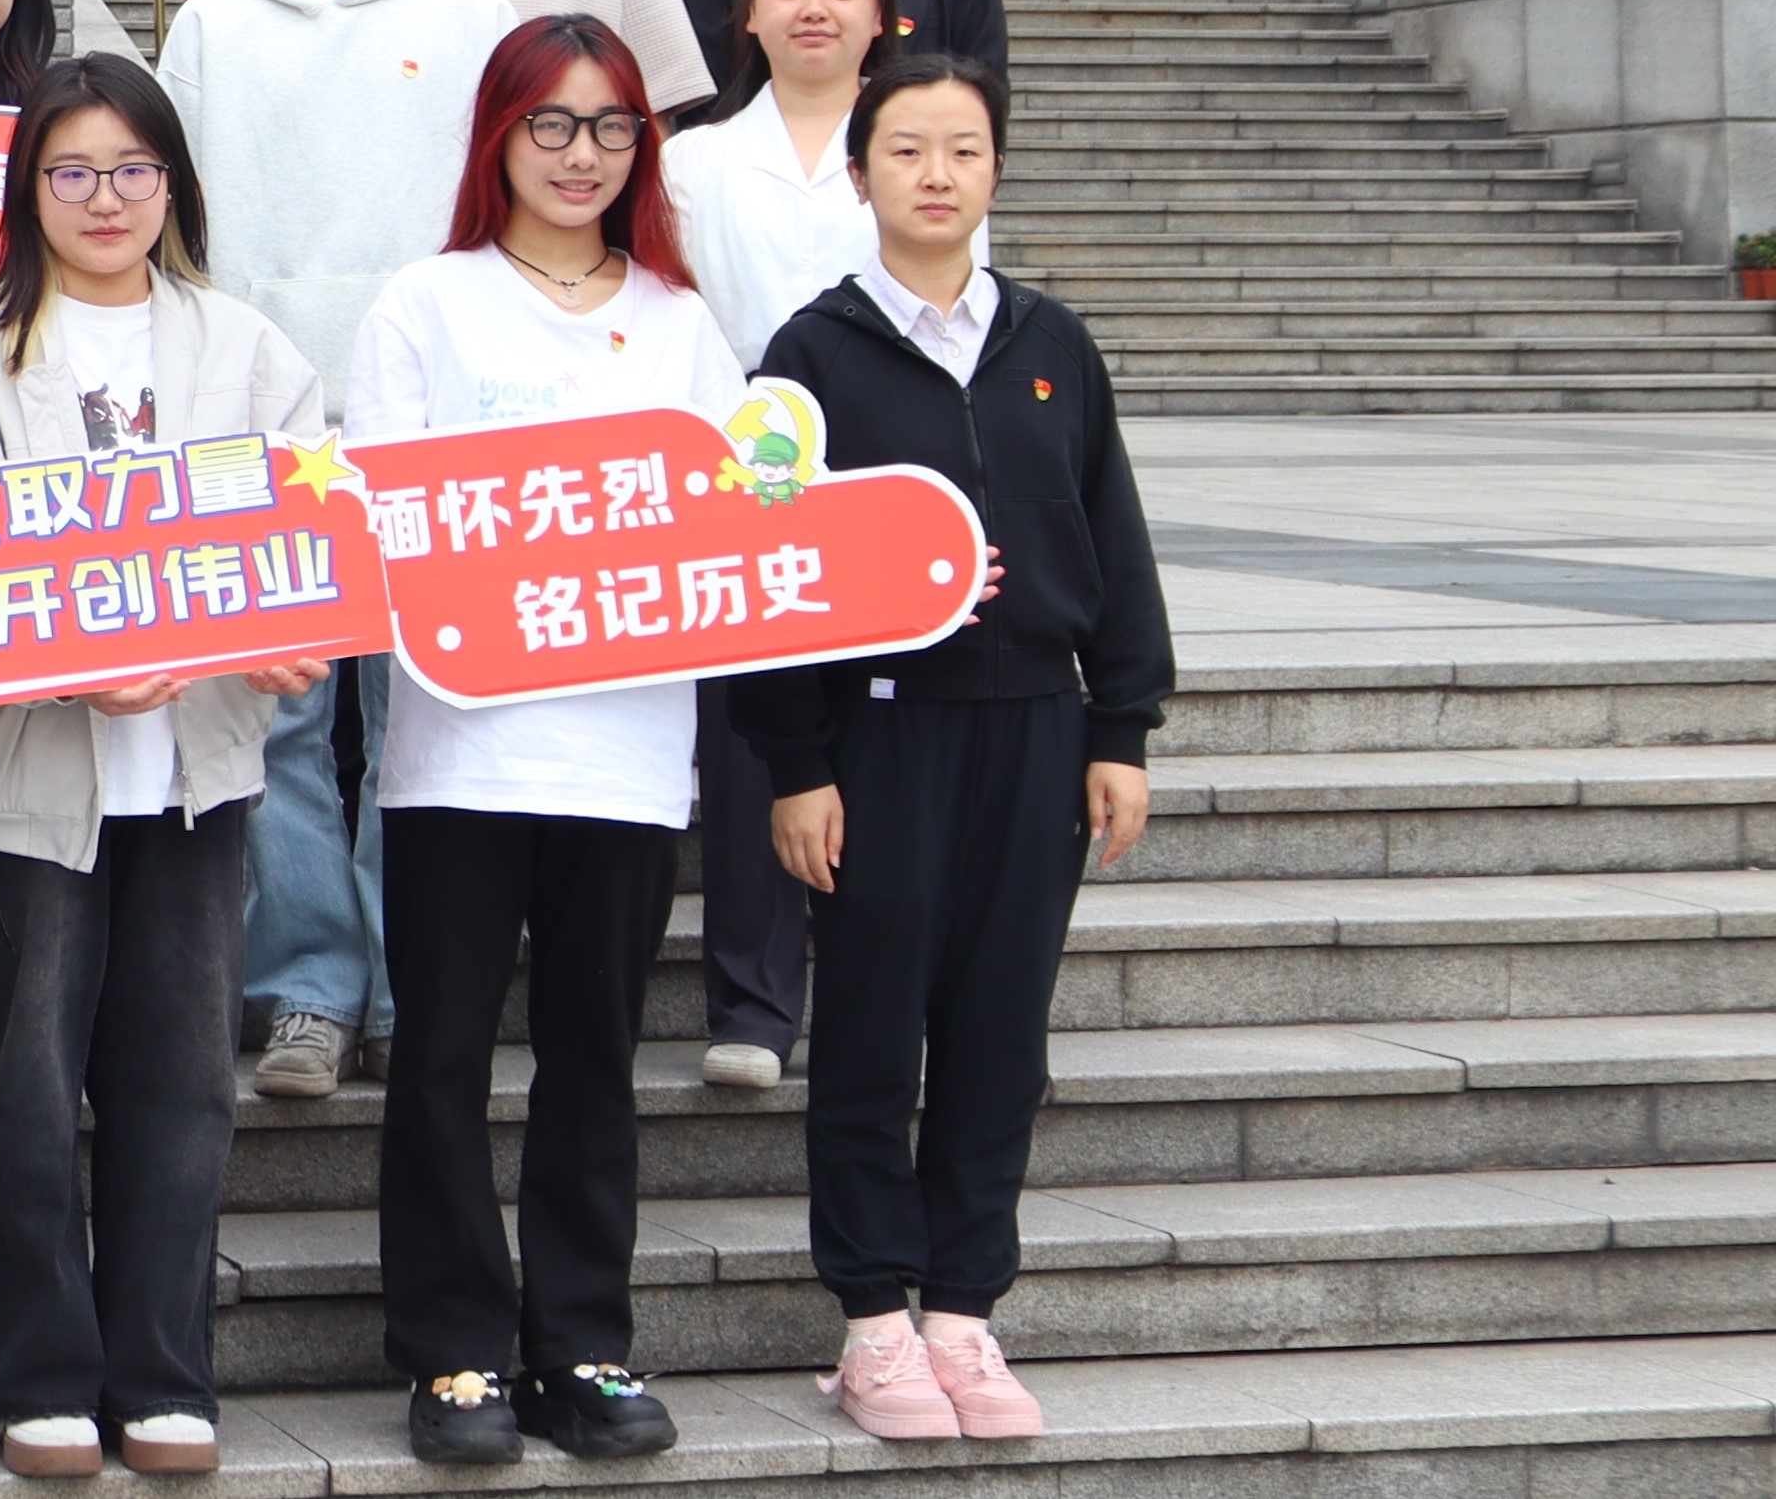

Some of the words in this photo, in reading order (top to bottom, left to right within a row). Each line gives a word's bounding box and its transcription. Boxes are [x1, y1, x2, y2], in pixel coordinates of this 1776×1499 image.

[367, 452, 675, 560] 缅怀先烈
[513, 543, 831, 653] 铭记历史
